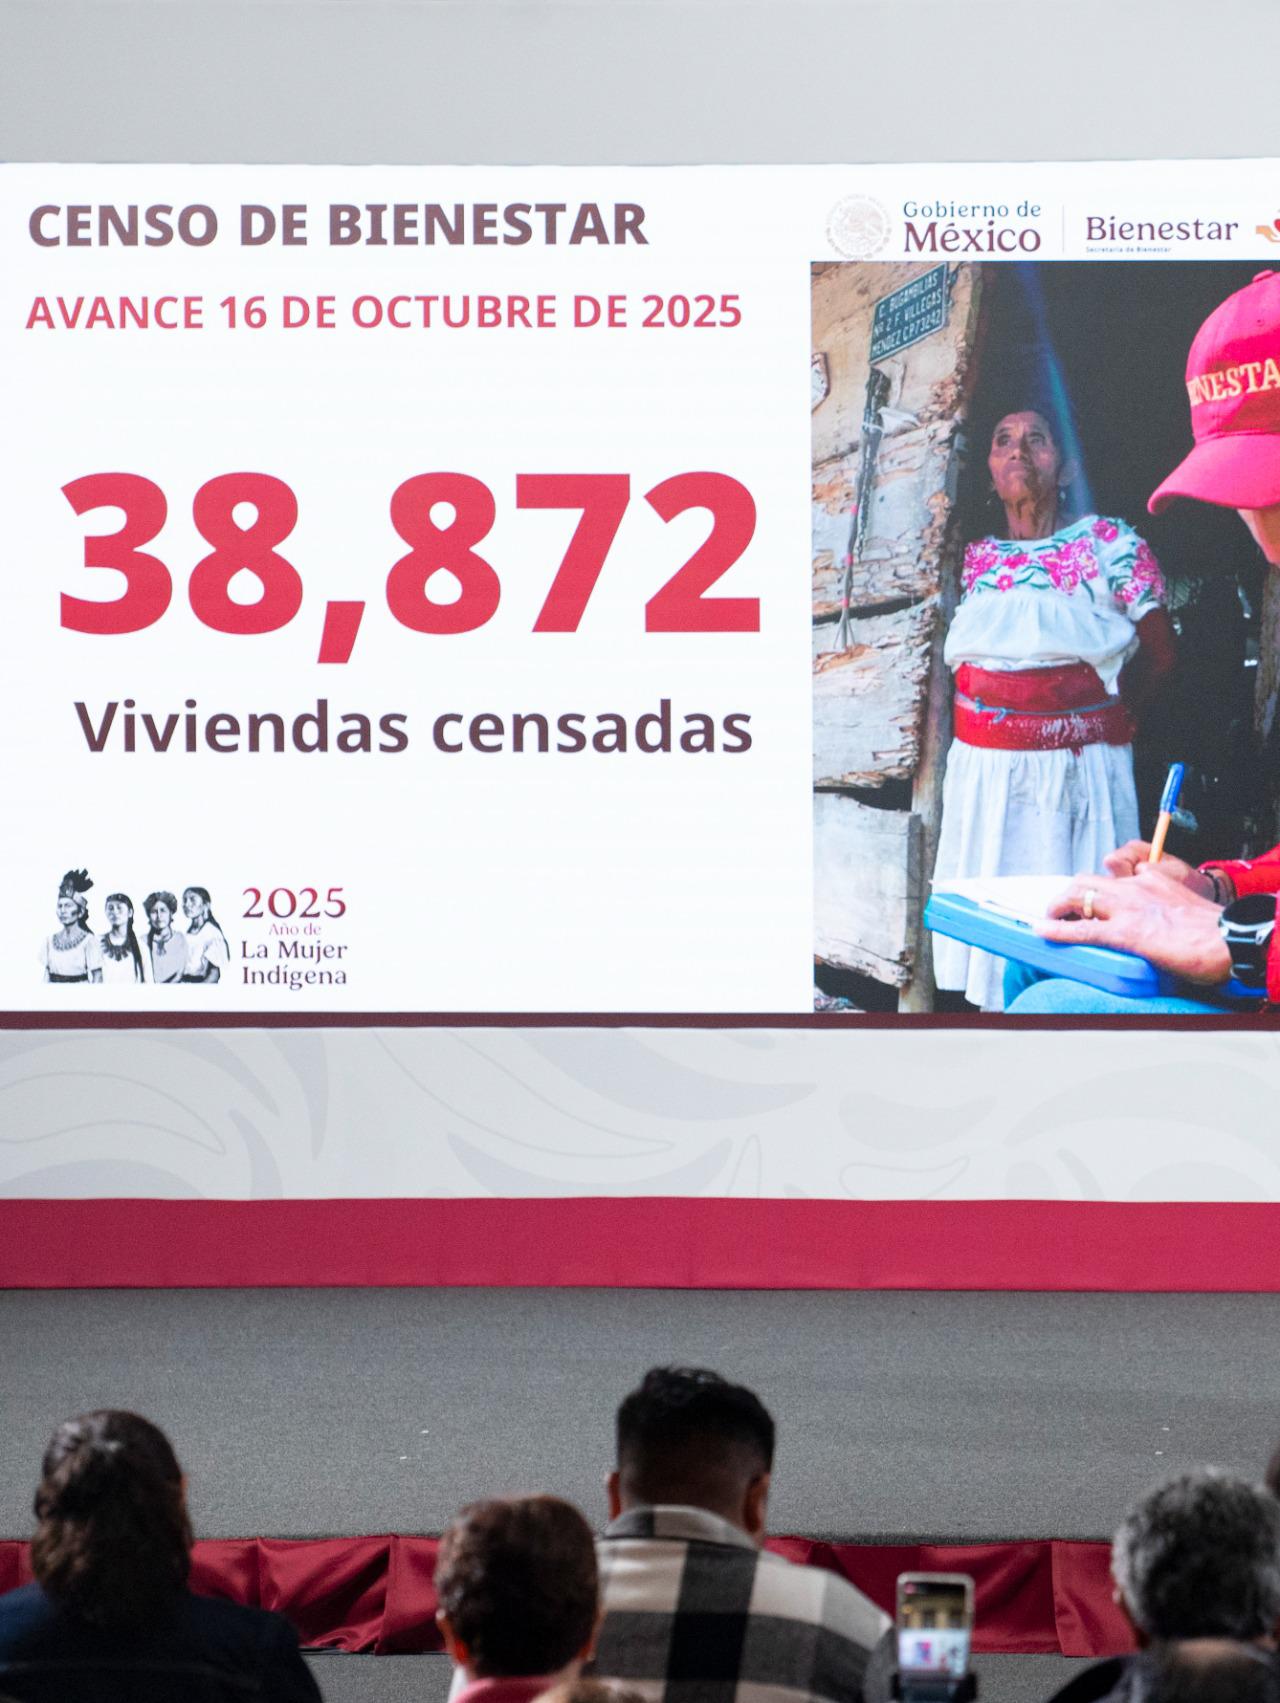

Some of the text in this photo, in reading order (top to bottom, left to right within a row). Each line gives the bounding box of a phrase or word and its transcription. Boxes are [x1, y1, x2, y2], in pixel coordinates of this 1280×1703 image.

[29, 202, 650, 248] CENSO DE BIENESTAR
[903, 200, 1041, 218] Gobierno de
[903, 219, 1042, 253] México
[1086, 215, 1239, 241] Bienestar
[26, 294, 742, 330] AVANCE 16 DE OCTUBRE DE 2025
[60, 471, 761, 664] 38,872
[74, 698, 753, 754] Viviendas censadas
[242, 887, 347, 919] 2025
[268, 922, 322, 936] Año de
[242, 939, 348, 964] La Mujer
[242, 964, 347, 991] Indígena
